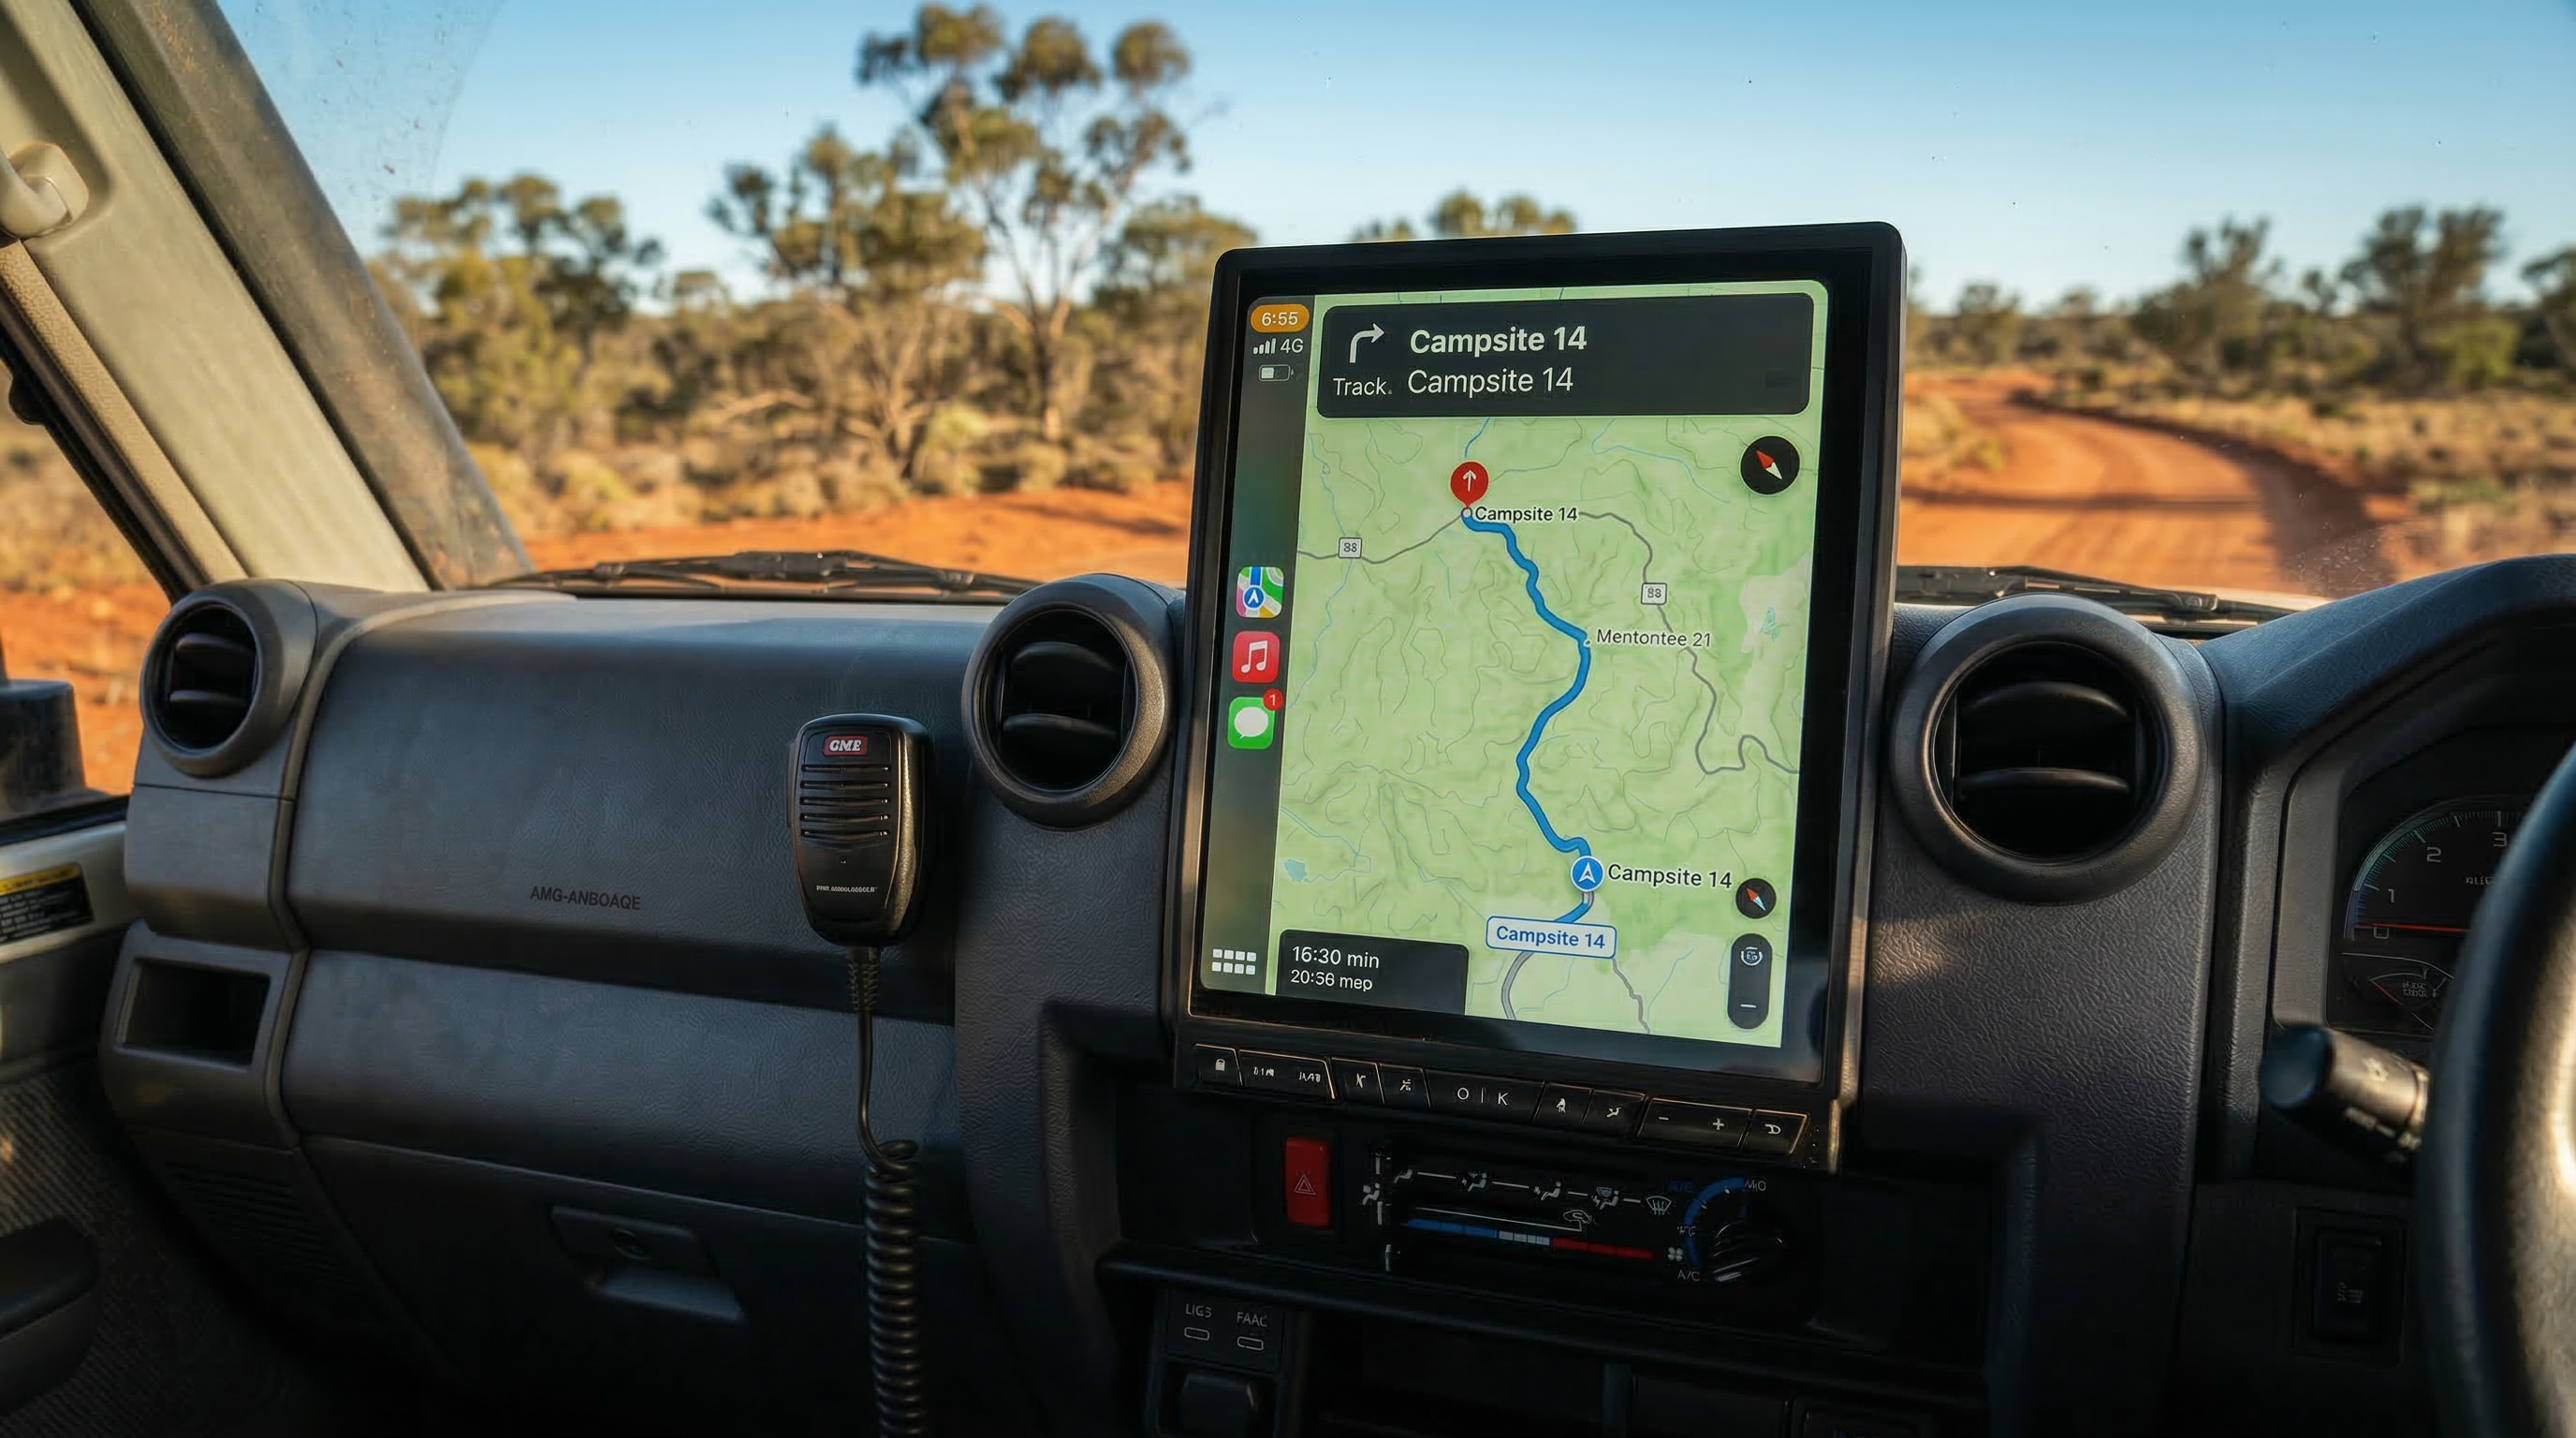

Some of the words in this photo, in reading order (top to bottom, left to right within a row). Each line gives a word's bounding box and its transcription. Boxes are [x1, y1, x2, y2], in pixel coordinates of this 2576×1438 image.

[1261, 311, 1299, 327] 6:55
[1280, 337, 1304, 354] 4G
[1410, 326, 1545, 358] Campsite
[1554, 326, 1588, 351] 14
[1408, 368, 1533, 398] Campsite
[1543, 366, 1573, 391] 14
[1474, 506, 1553, 521] Campsite
[1559, 506, 1578, 521] 14
[1343, 542, 1357, 553] 88
[1597, 628, 1687, 646] Mentontee
[1692, 632, 1711, 647] 21
[1269, 694, 1276, 706] 1
[828, 739, 862, 752] GME
[2493, 831, 2508, 847] 3
[2426, 846, 2441, 862] 2
[1607, 863, 1702, 886] Campsite
[1708, 872, 1733, 888] 14
[2388, 888, 2395, 903] 1
[1497, 925, 1579, 946] Campsite
[1585, 932, 1605, 948] 14
[1292, 946, 1341, 965] 16:30
[1347, 951, 1380, 969] min
[1339, 976, 1373, 992] mep
[1676, 1269, 1701, 1282] A/C
